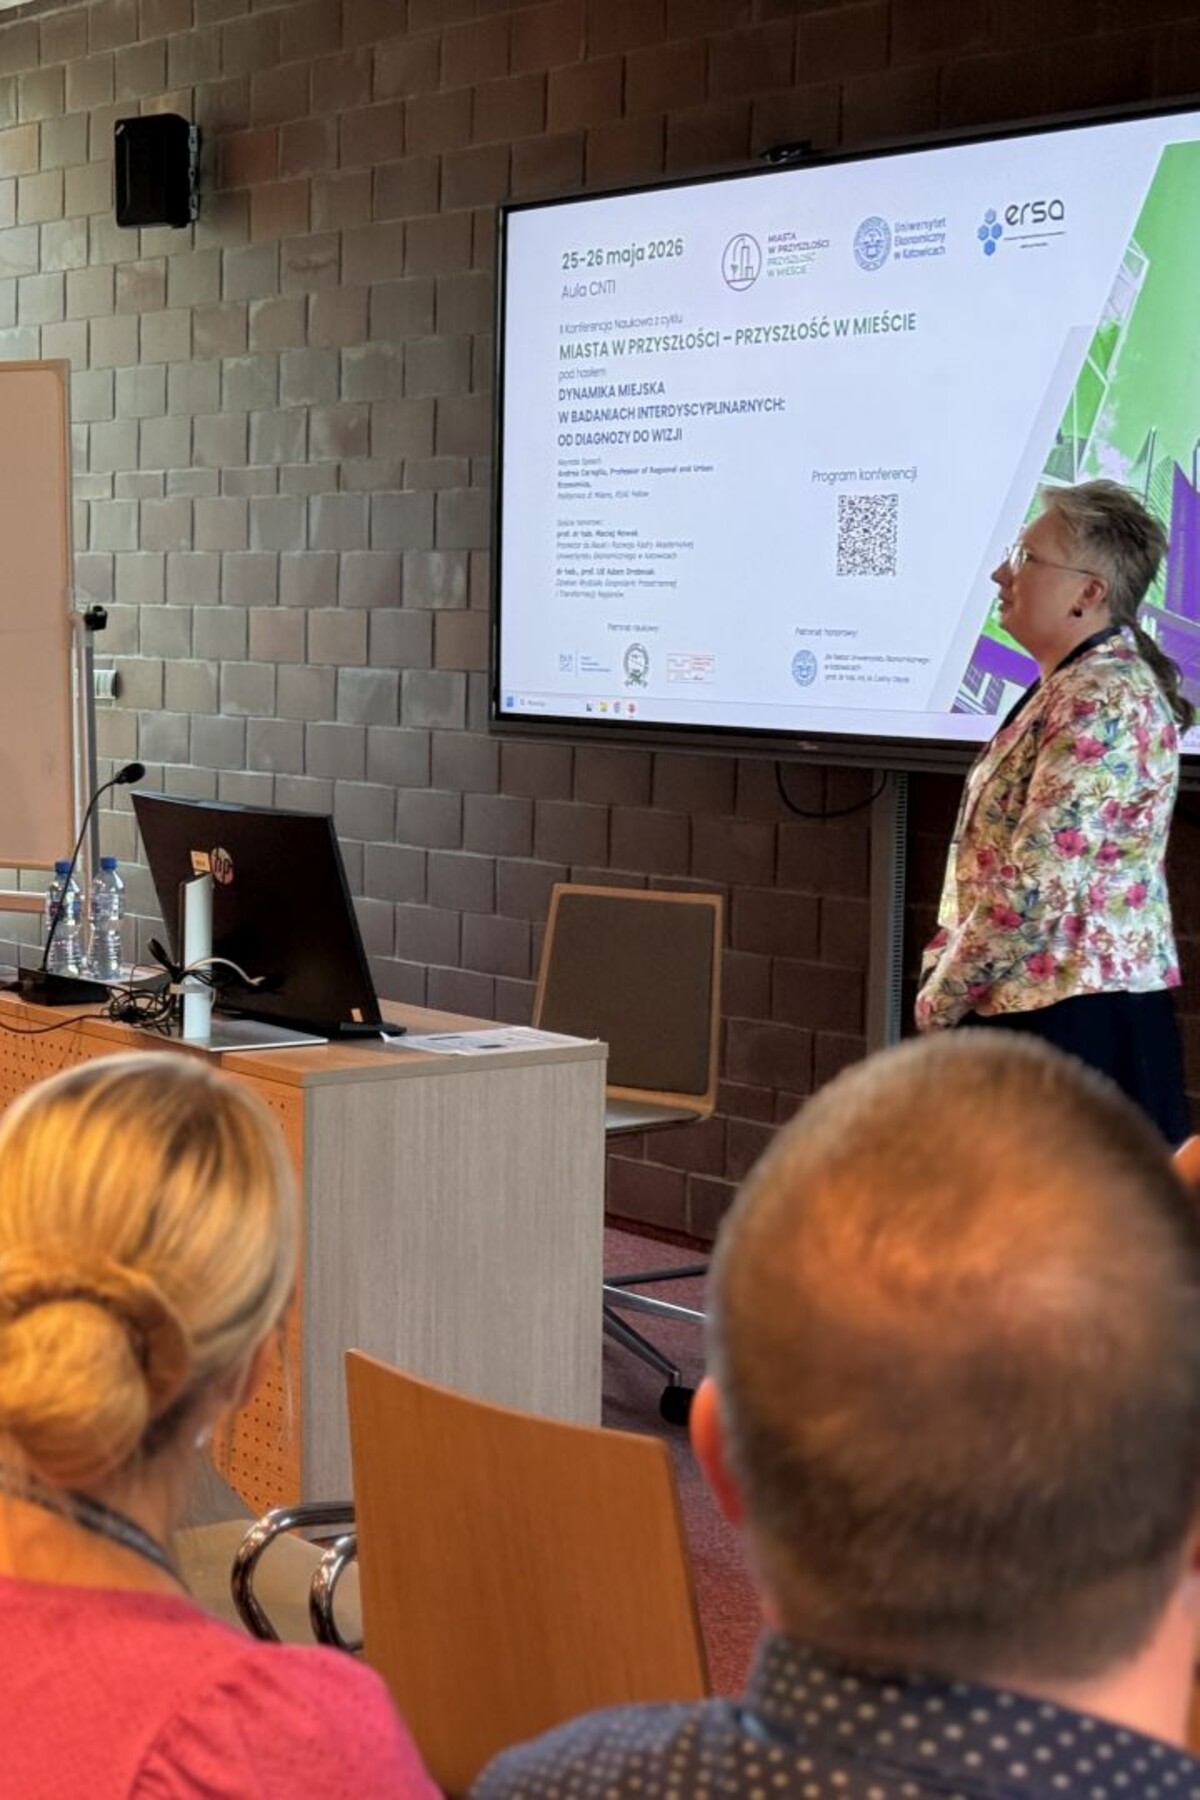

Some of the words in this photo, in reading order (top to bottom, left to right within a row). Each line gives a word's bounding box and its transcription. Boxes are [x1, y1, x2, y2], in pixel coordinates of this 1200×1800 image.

[1004, 199, 1065, 226] ersa
[561, 247, 605, 270] 25-26
[606, 243, 645, 269] maja
[647, 239, 684, 260] 2026
[561, 283, 588, 300] Aula
[559, 341, 609, 361] MIASTA
[612, 339, 626, 356] W
[628, 327, 720, 354] PRZYSZŁOŚCI
[735, 315, 830, 346] PRZYSZŁOŚĆ
[834, 319, 851, 337] W
[853, 310, 916, 336] MIEŚCIE
[558, 385, 615, 402] DYNAMIKA
[617, 381, 666, 398] MIEJSKA
[558, 411, 571, 424] W
[571, 407, 636, 423] BADANIACH
[557, 433, 574, 447] OD
[575, 430, 631, 446] DIAGNOZY
[633, 429, 650, 444] DO
[651, 427, 683, 443] WIZJI
[811, 470, 858, 486] Program
[858, 466, 918, 484] konferencji
[212, 847, 233, 885] hp
